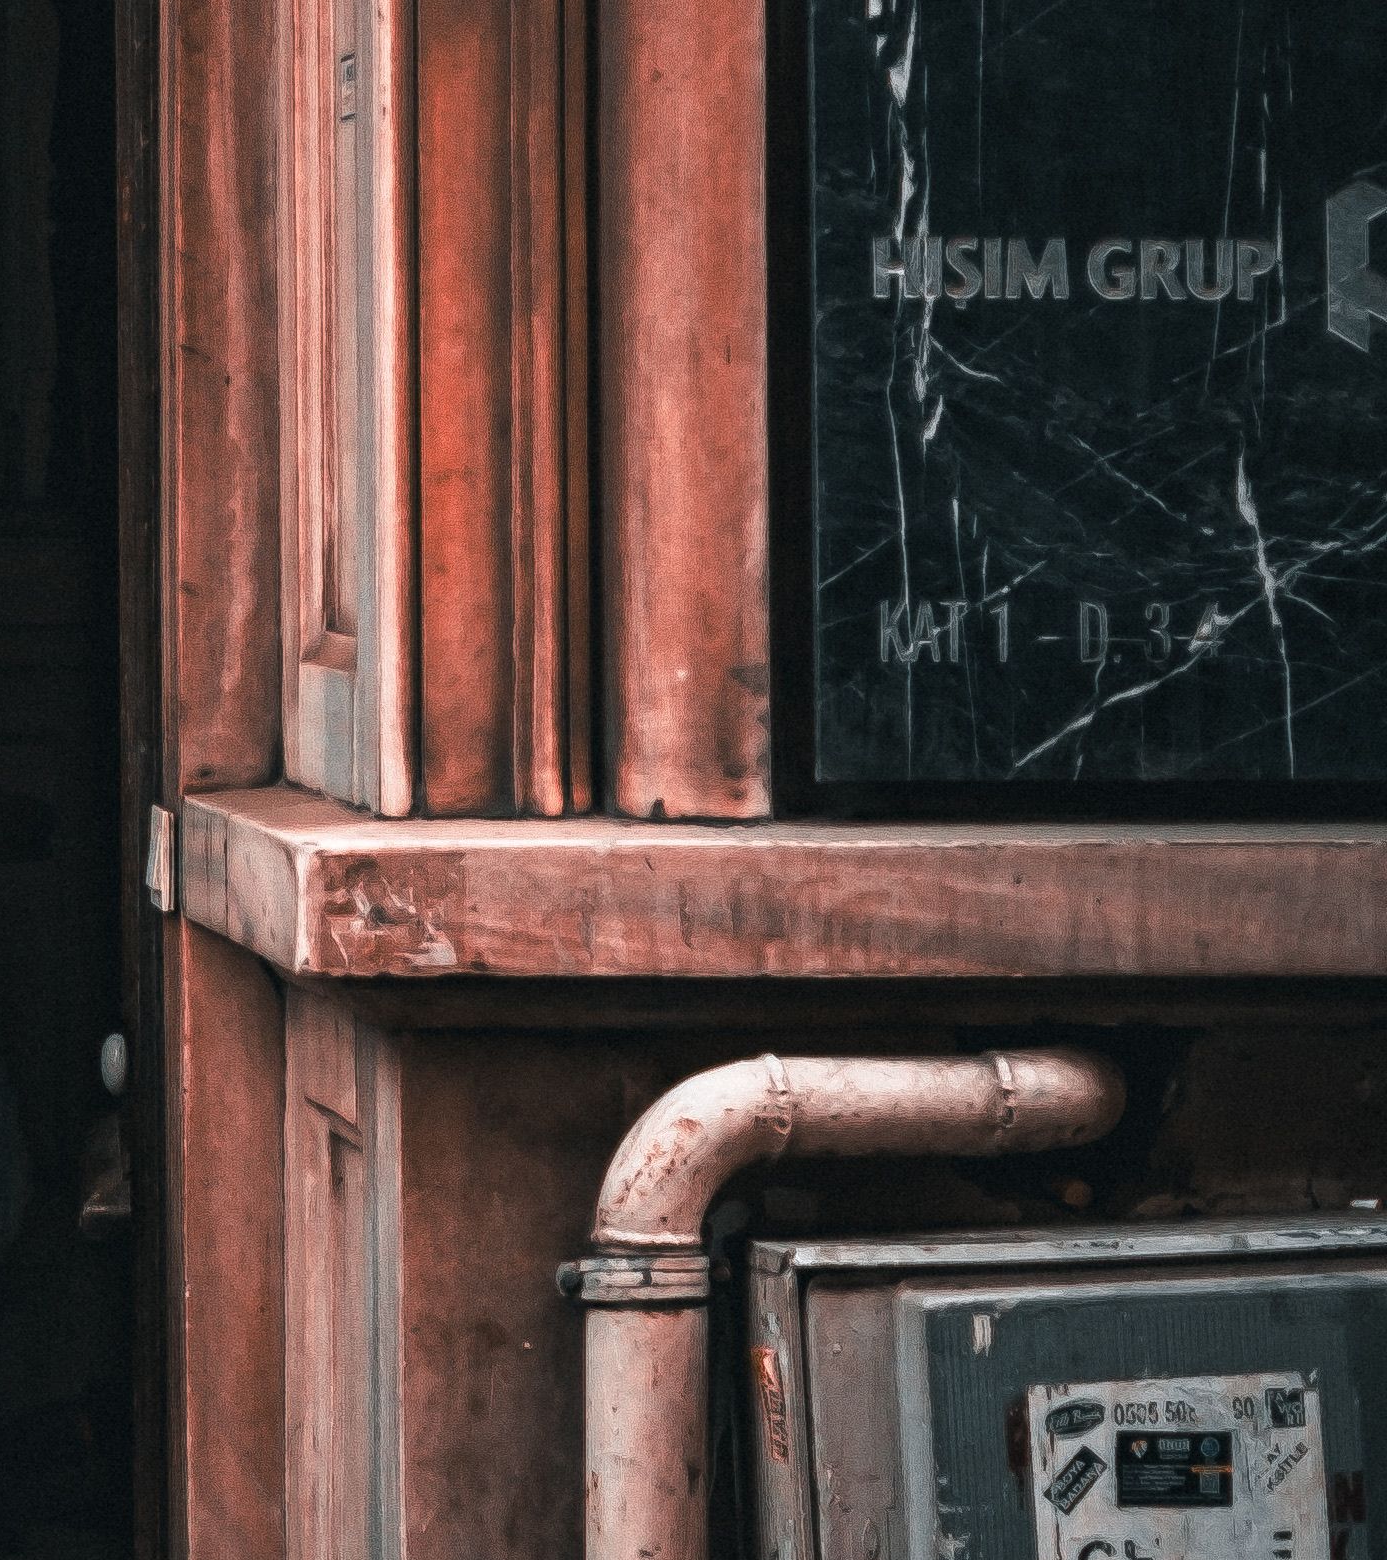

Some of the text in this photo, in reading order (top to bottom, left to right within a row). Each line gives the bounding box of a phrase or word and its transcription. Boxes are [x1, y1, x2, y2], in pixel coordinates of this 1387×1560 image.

[1087, 236, 1278, 302] GRUP
[879, 598, 968, 664] KAT
[988, 599, 1008, 664] 1
